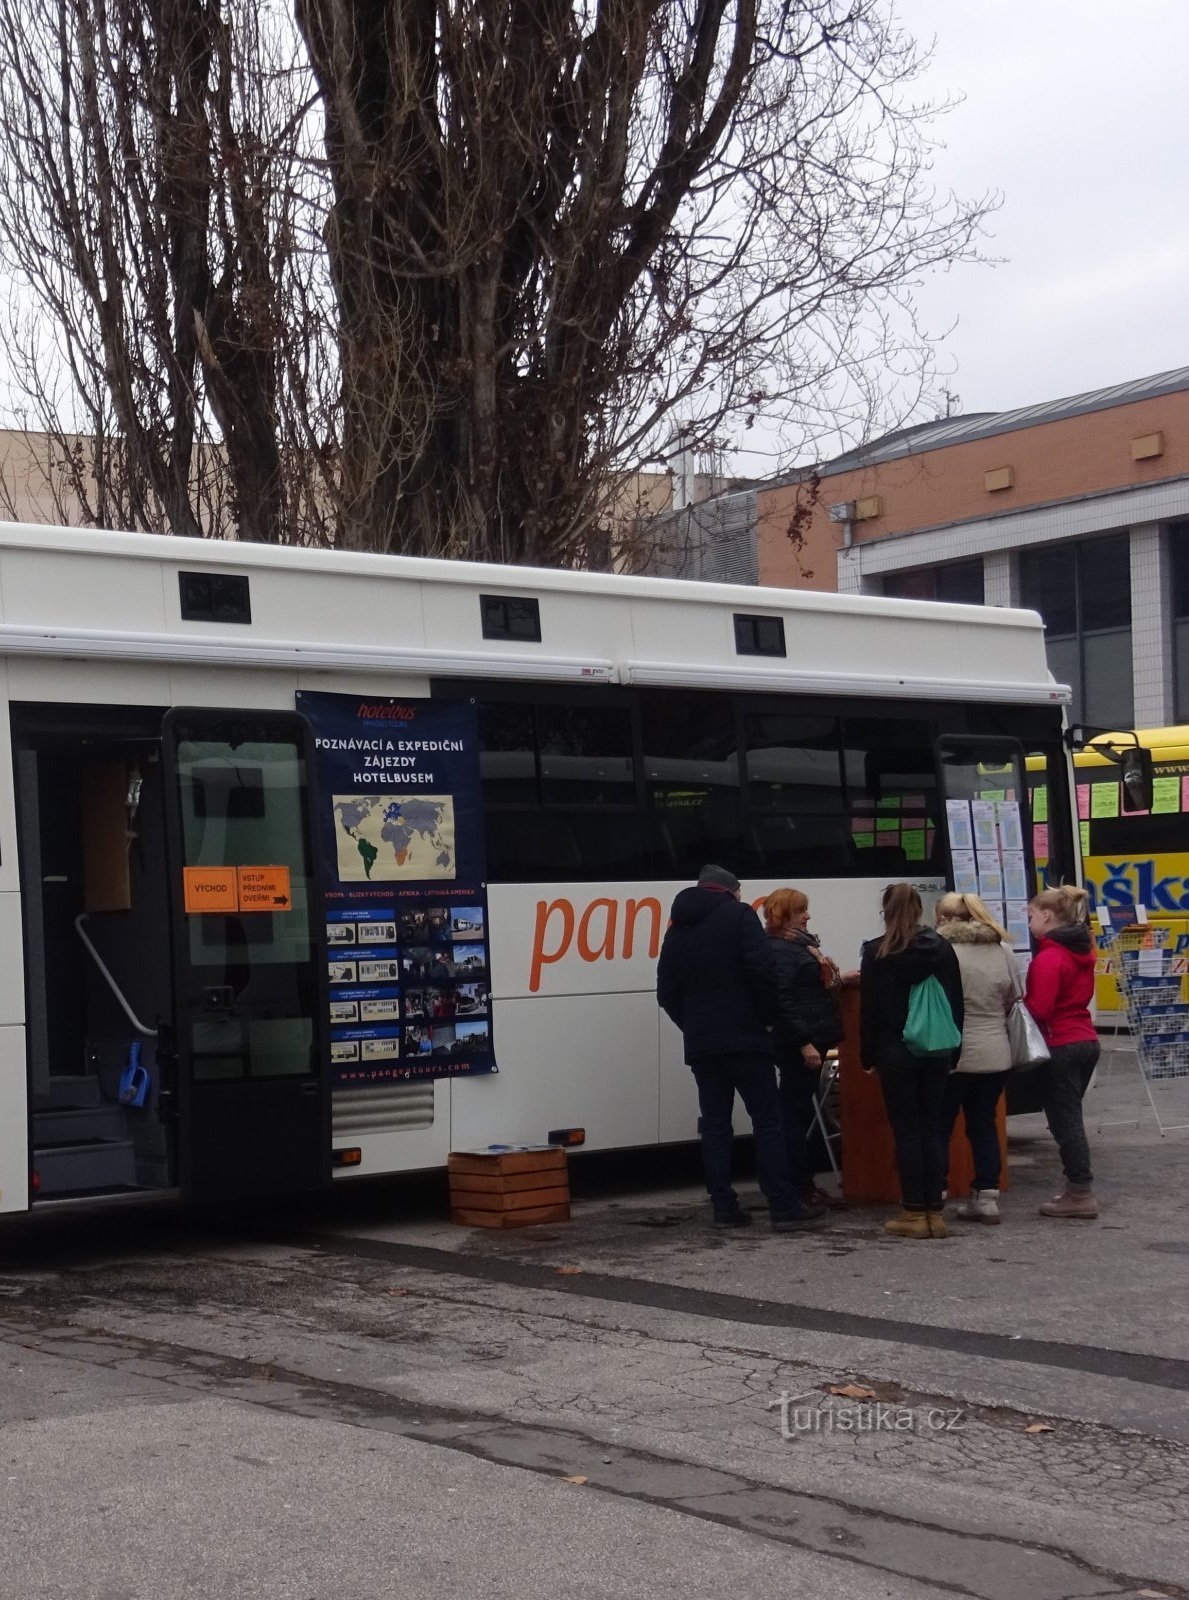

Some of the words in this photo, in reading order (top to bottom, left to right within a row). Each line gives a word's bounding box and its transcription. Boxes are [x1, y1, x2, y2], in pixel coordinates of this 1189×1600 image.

[357, 703, 416, 720] hotelbus
[315, 738, 383, 751] POZNÁVACÍ
[386, 742, 395, 751] A
[398, 739, 464, 752] EXPEDIČNÍ
[364, 755, 417, 769] ZÁJEZDY
[353, 772, 434, 783] HOTELBUSEM
[194, 883, 228, 893] VÝCHOD
[340, 1062, 471, 1080] www.pangeotours.com
